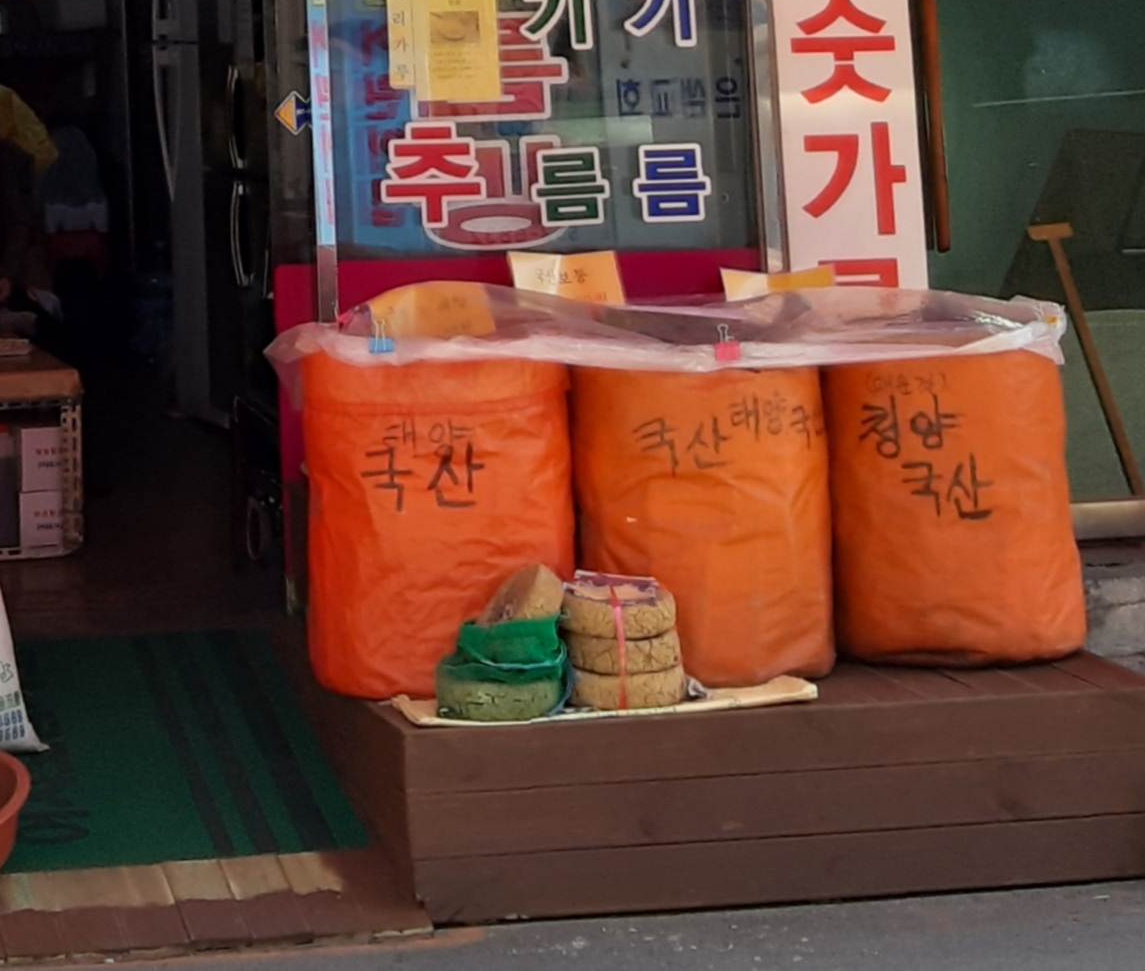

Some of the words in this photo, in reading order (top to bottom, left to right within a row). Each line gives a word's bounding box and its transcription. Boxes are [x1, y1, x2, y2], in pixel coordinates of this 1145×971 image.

[633, 416, 732, 477] 국산
[858, 393, 964, 459] 청양
[360, 440, 485, 513] 국산
[900, 452, 995, 520] 국산
